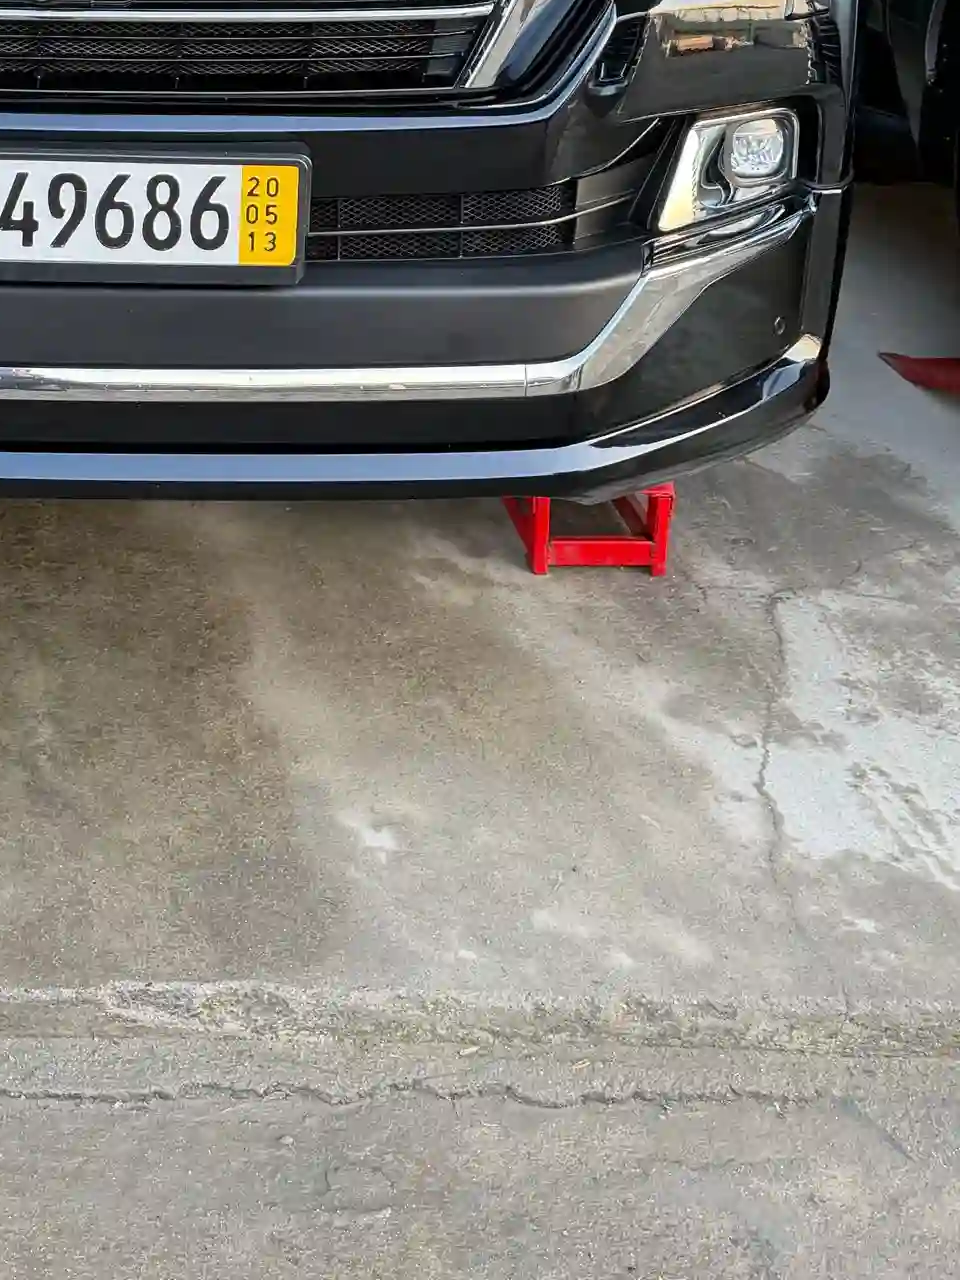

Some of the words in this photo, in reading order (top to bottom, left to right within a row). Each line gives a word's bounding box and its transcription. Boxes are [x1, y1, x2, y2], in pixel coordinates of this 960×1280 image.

[246, 176, 280, 198] 20
[245, 203, 278, 225] 05
[247, 231, 277, 252] 13
